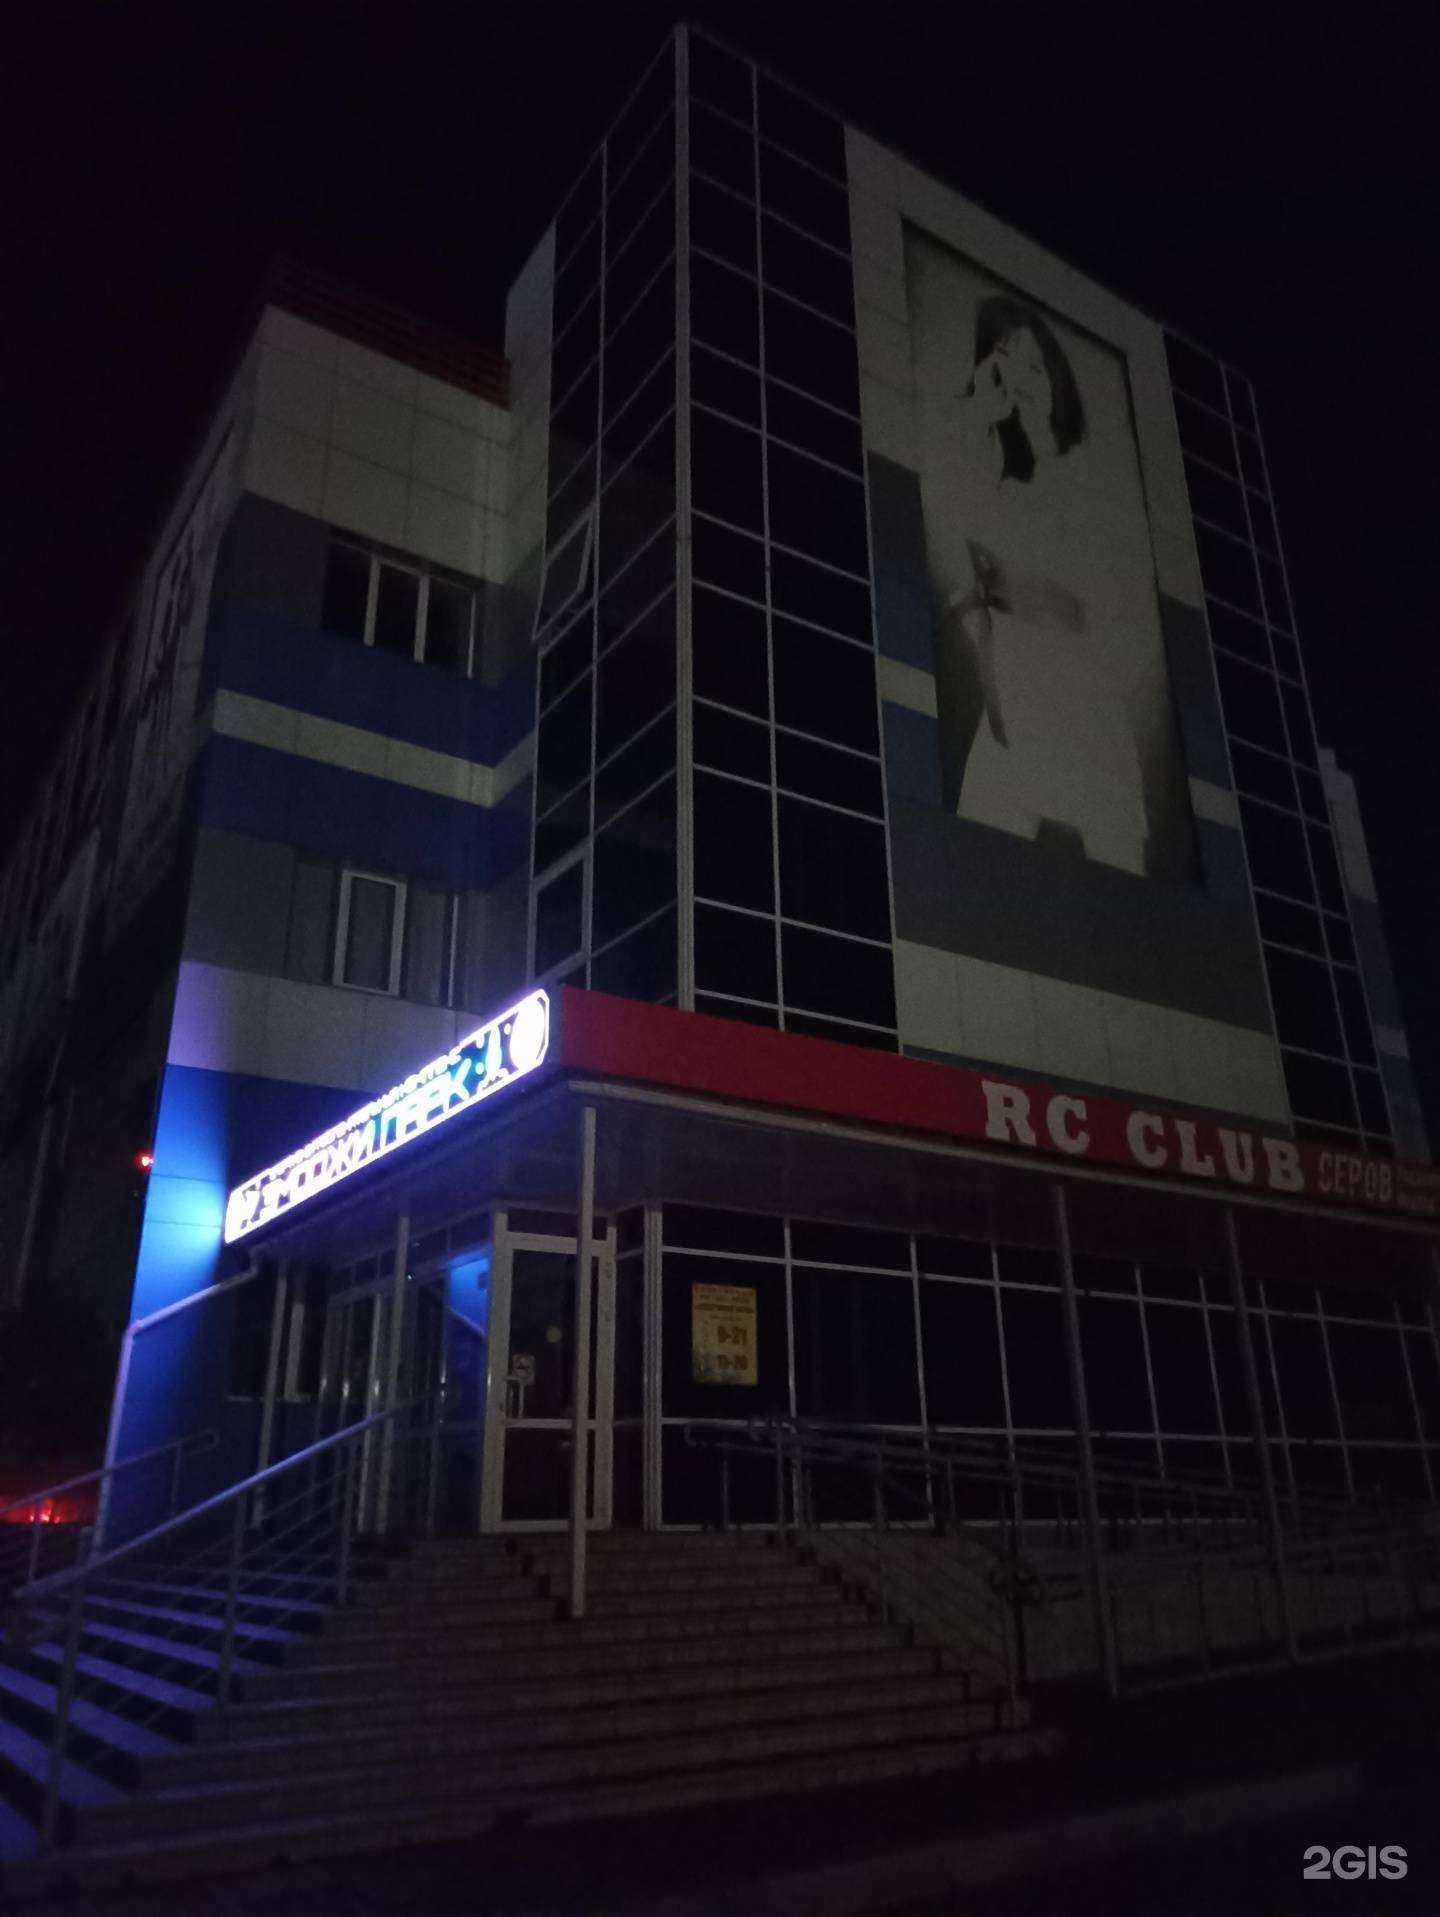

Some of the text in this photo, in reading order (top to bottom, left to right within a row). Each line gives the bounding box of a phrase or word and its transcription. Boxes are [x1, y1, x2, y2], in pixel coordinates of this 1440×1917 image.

[981, 1079, 1305, 1192] RC CLUB
[1317, 1151, 1393, 1202] СЕРОВ
